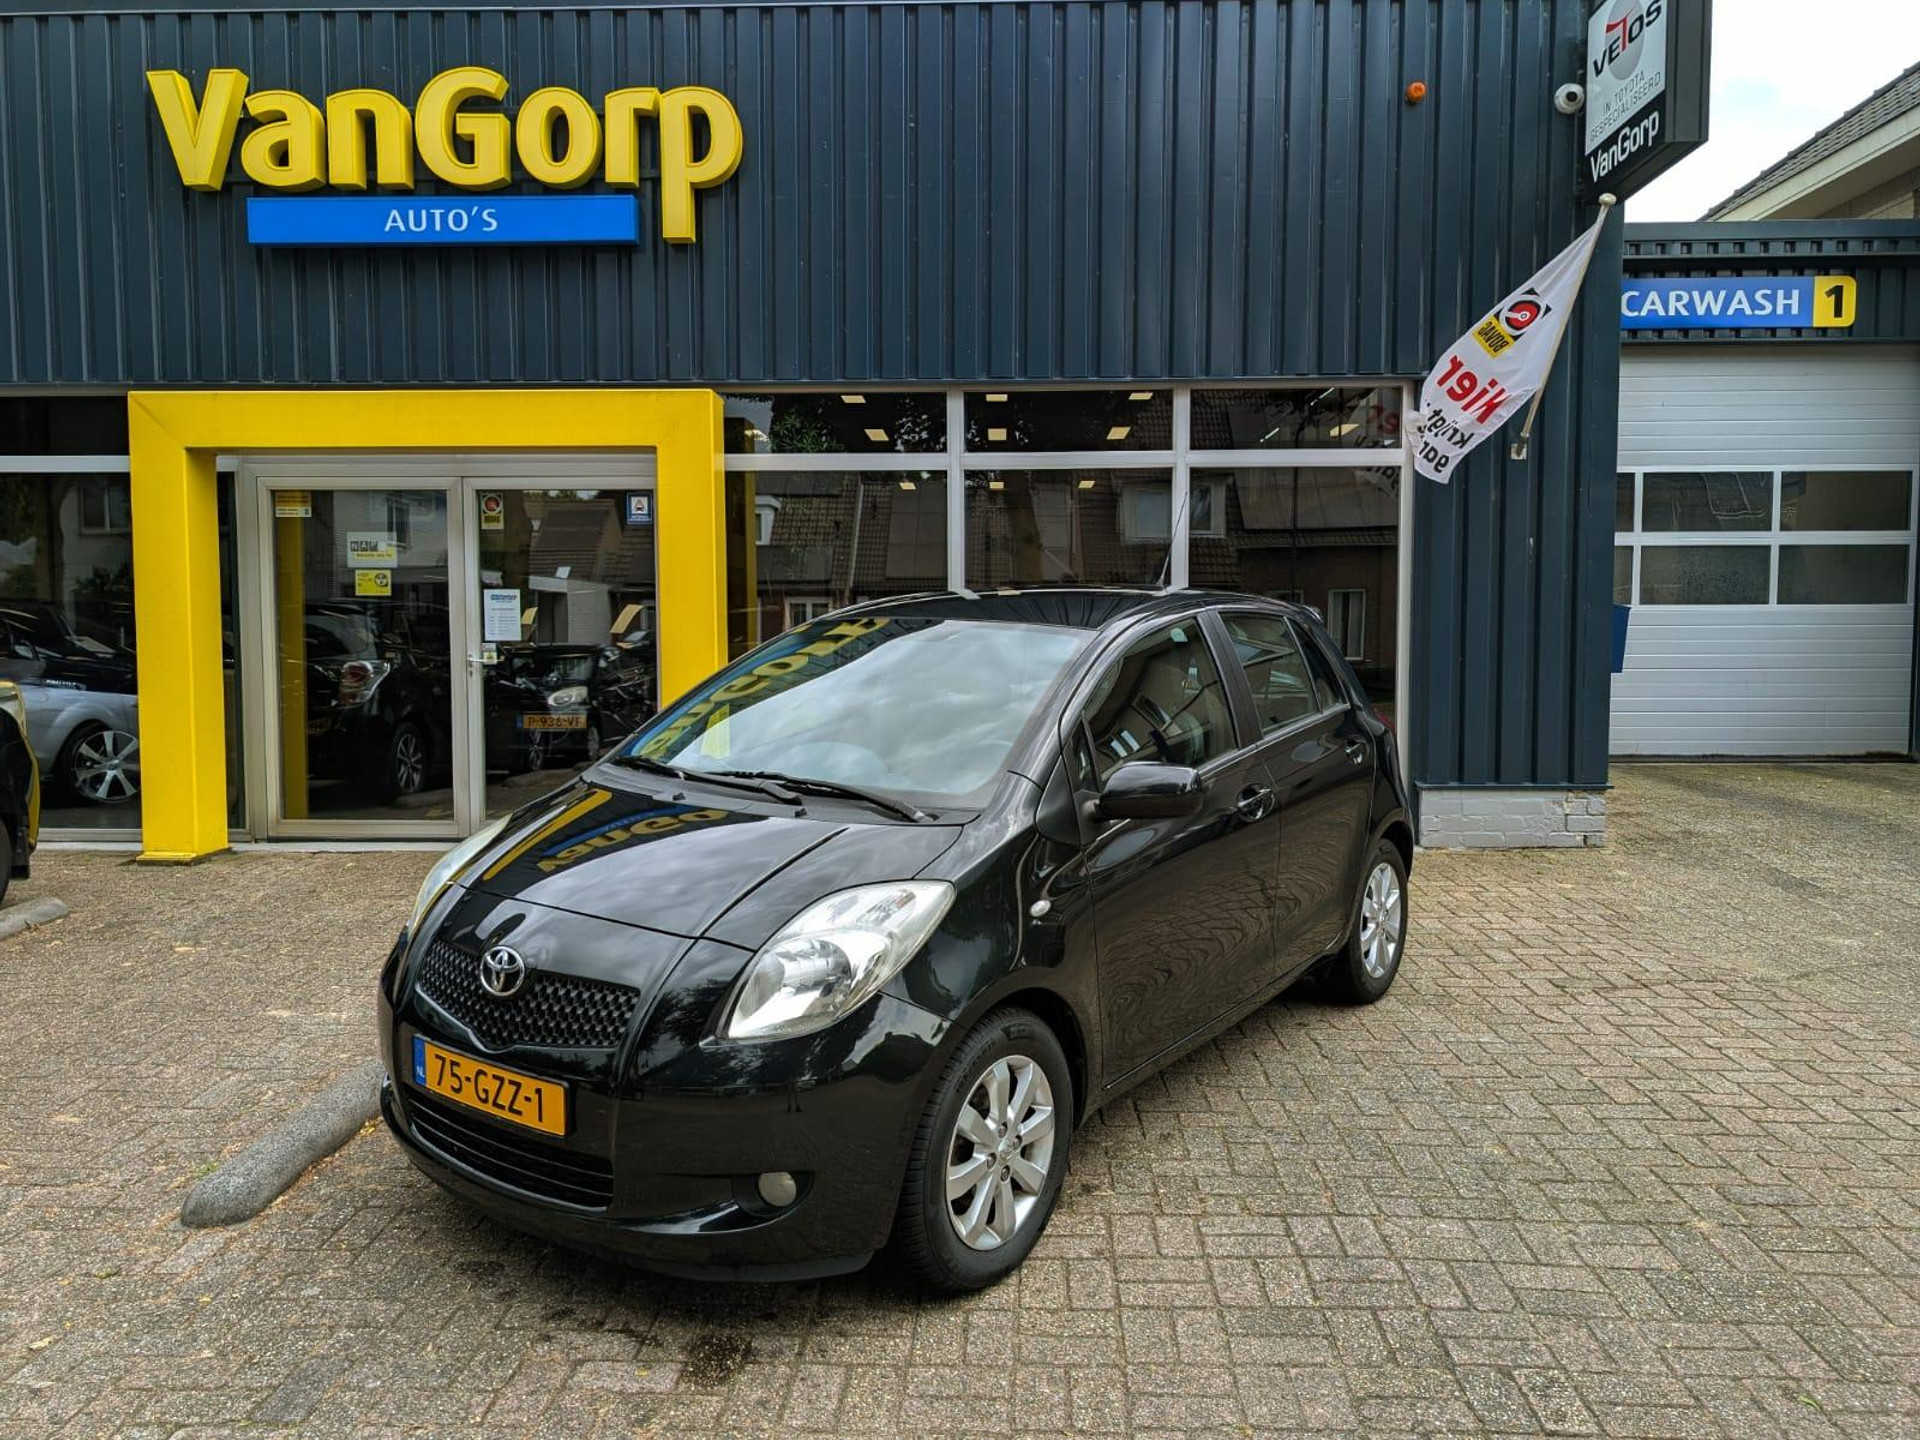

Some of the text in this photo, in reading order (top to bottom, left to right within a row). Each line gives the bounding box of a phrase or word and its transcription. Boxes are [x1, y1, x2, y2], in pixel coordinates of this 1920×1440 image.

[146, 66, 744, 244] VanGorp
[1590, 110, 1660, 183] VanGorp
[384, 207, 498, 232] AUTO'S
[1620, 285, 1845, 319] CARWASH 1
[435, 1053, 544, 1123] 75-GZZ-1
